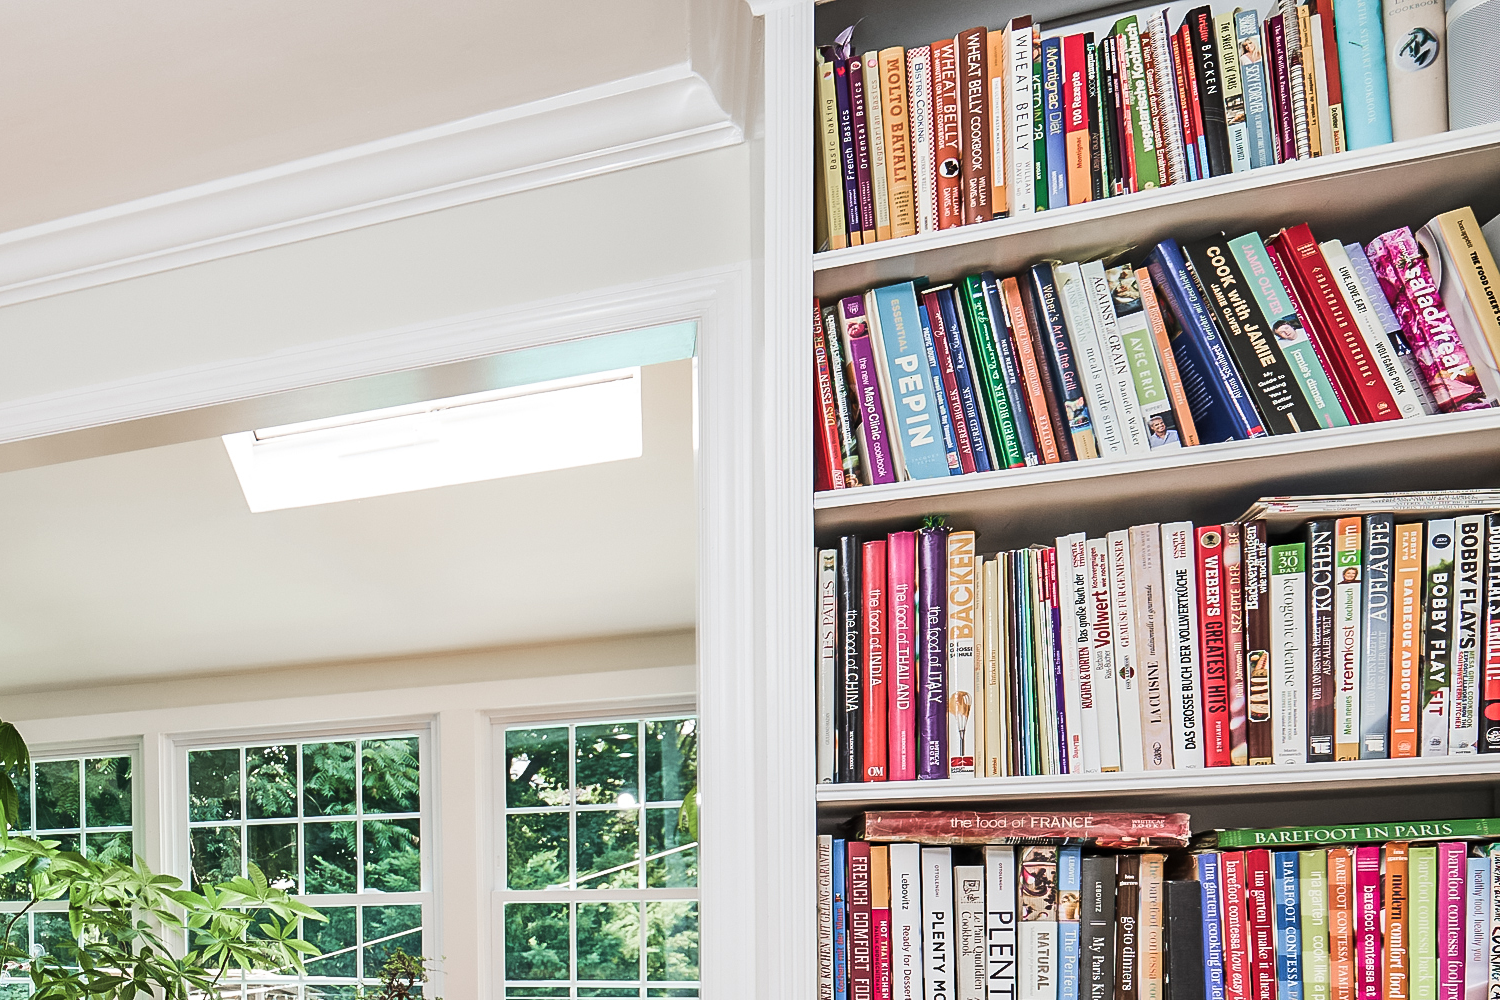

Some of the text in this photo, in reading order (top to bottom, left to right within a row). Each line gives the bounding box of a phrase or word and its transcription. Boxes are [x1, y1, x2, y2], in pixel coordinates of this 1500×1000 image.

[887, 60, 903, 117] MOLTO
[966, 33, 982, 171] WHEAT BELLY COOKBOOK
[1015, 35, 1029, 151] WHEAT BELLY
[1045, 47, 1061, 109] Montignac
[1071, 71, 1082, 126] 100 Rezepte
[1201, 44, 1217, 95] BACKEN
[1245, 66, 1264, 115] SEXY FOREVER
[826, 99, 838, 170] Basic baking
[842, 110, 855, 180] French Basics
[891, 124, 907, 183] BATALI
[1042, 284, 1076, 391] Weber's Art of the Grill
[1206, 245, 1276, 367] COOK with JAMIE
[1405, 267, 1470, 380] salad freak
[891, 299, 934, 447] ESSENTIAL PEPIN
[1086, 347, 1119, 453] meals made simple
[1130, 337, 1157, 399] AVEC ERIC
[1305, 378, 1326, 409] dinners
[1374, 342, 1405, 395] WOLFGANG PUCK
[859, 358, 886, 478] the new Mayo Clinic cookbook
[949, 538, 973, 640] BACKEN
[1312, 531, 1332, 611] KOCHEN
[846, 610, 858, 712] the food of CHINA
[929, 606, 942, 703] the food of ITALY
[1205, 555, 1226, 714] WEBER'S GREATEST HITS
[1400, 579, 1413, 722] BARBECUE ADDICTION
[1429, 572, 1448, 717] BOBBY FLAY FIT
[949, 815, 1094, 830] the food of FRANCE
[1254, 821, 1454, 845] BAREFOOT IN PARIS
[853, 857, 868, 905] FRENCH
[853, 913, 869, 972] COMFORT
[901, 873, 912, 1000] Lebovitz Ready for Dessert
[932, 911, 946, 974] PLENTY
[1037, 932, 1050, 990] NATURAL
[1089, 937, 1104, 953] My
[1092, 955, 1104, 981] Paris
[1389, 874, 1406, 999] modern comfort food
